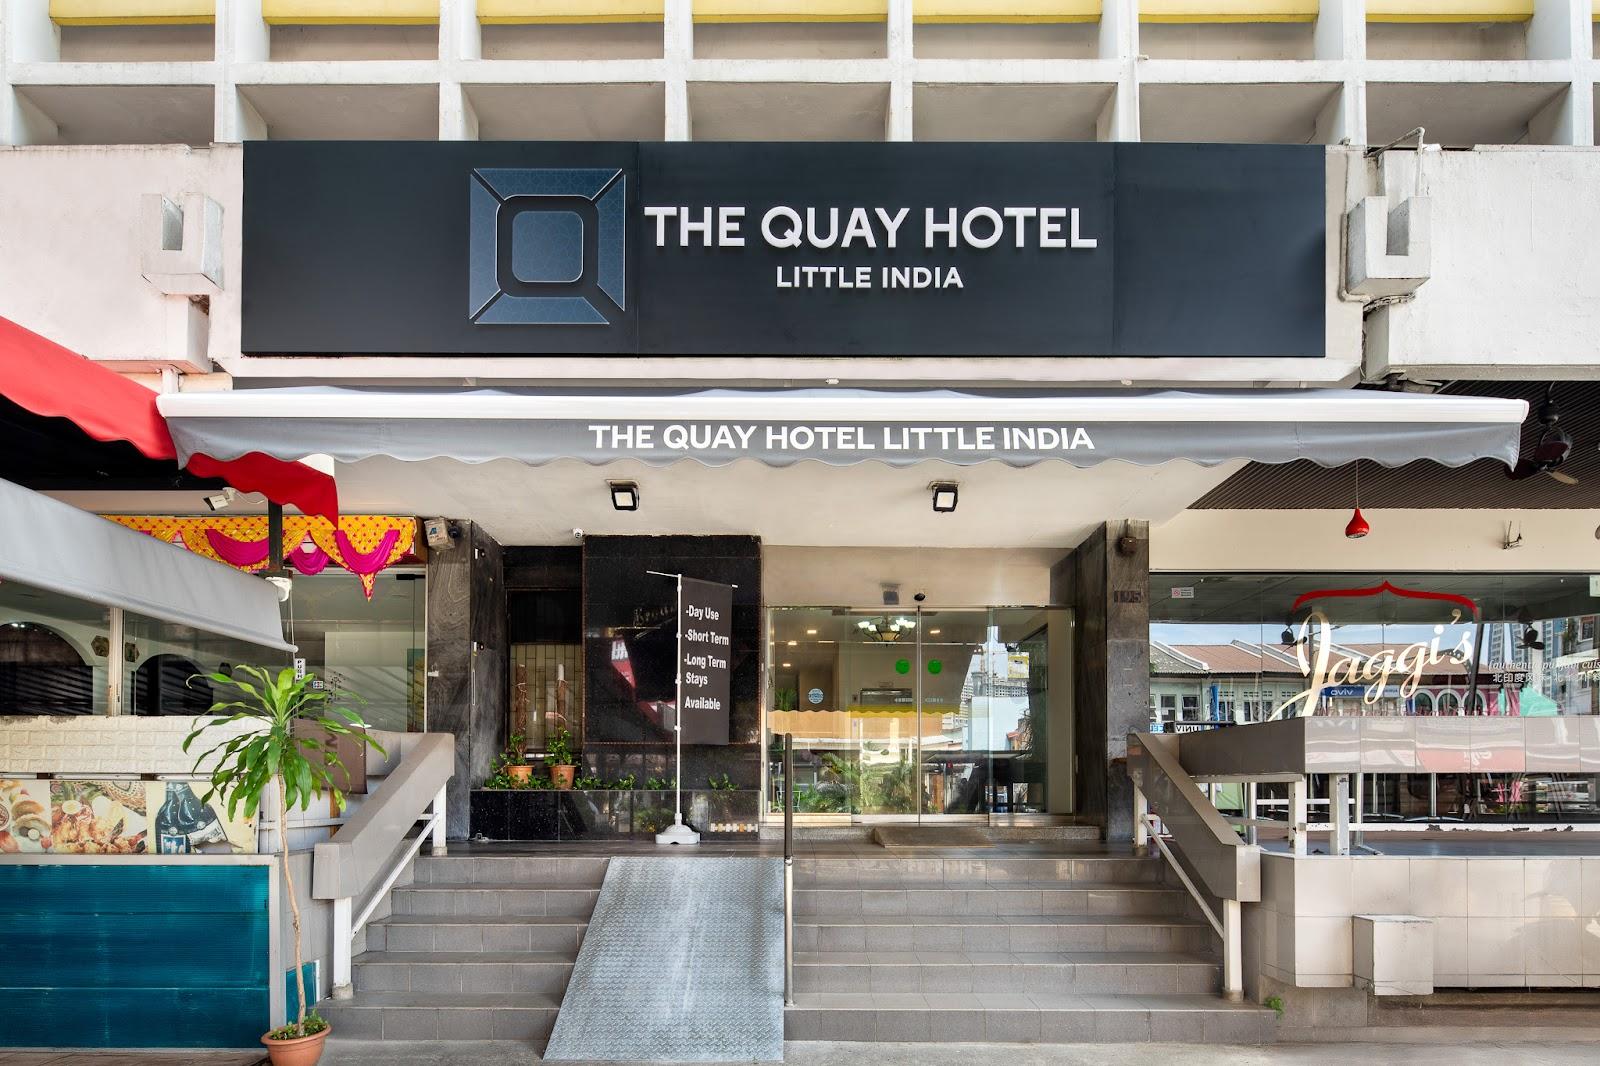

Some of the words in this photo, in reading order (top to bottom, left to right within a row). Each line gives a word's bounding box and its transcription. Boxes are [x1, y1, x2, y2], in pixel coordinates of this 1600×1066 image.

[644, 206, 746, 247] THE
[761, 206, 911, 249] QUAY
[925, 206, 1098, 248] HOTEL
[776, 266, 872, 289] LITTLE
[882, 267, 964, 289] INDIA
[588, 425, 655, 450] THE
[663, 424, 757, 450] QUAY
[766, 426, 876, 450] HOTEL
[883, 426, 995, 451] LITTLE
[1003, 427, 1096, 450] INDIA
[705, 607, 720, 621] Use
[710, 632, 729, 646] Term
[707, 655, 727, 669] Term
[1267, 608, 1473, 722] Jaggi's
[685, 672, 708, 687] Stays
[685, 696, 721, 710] Available
